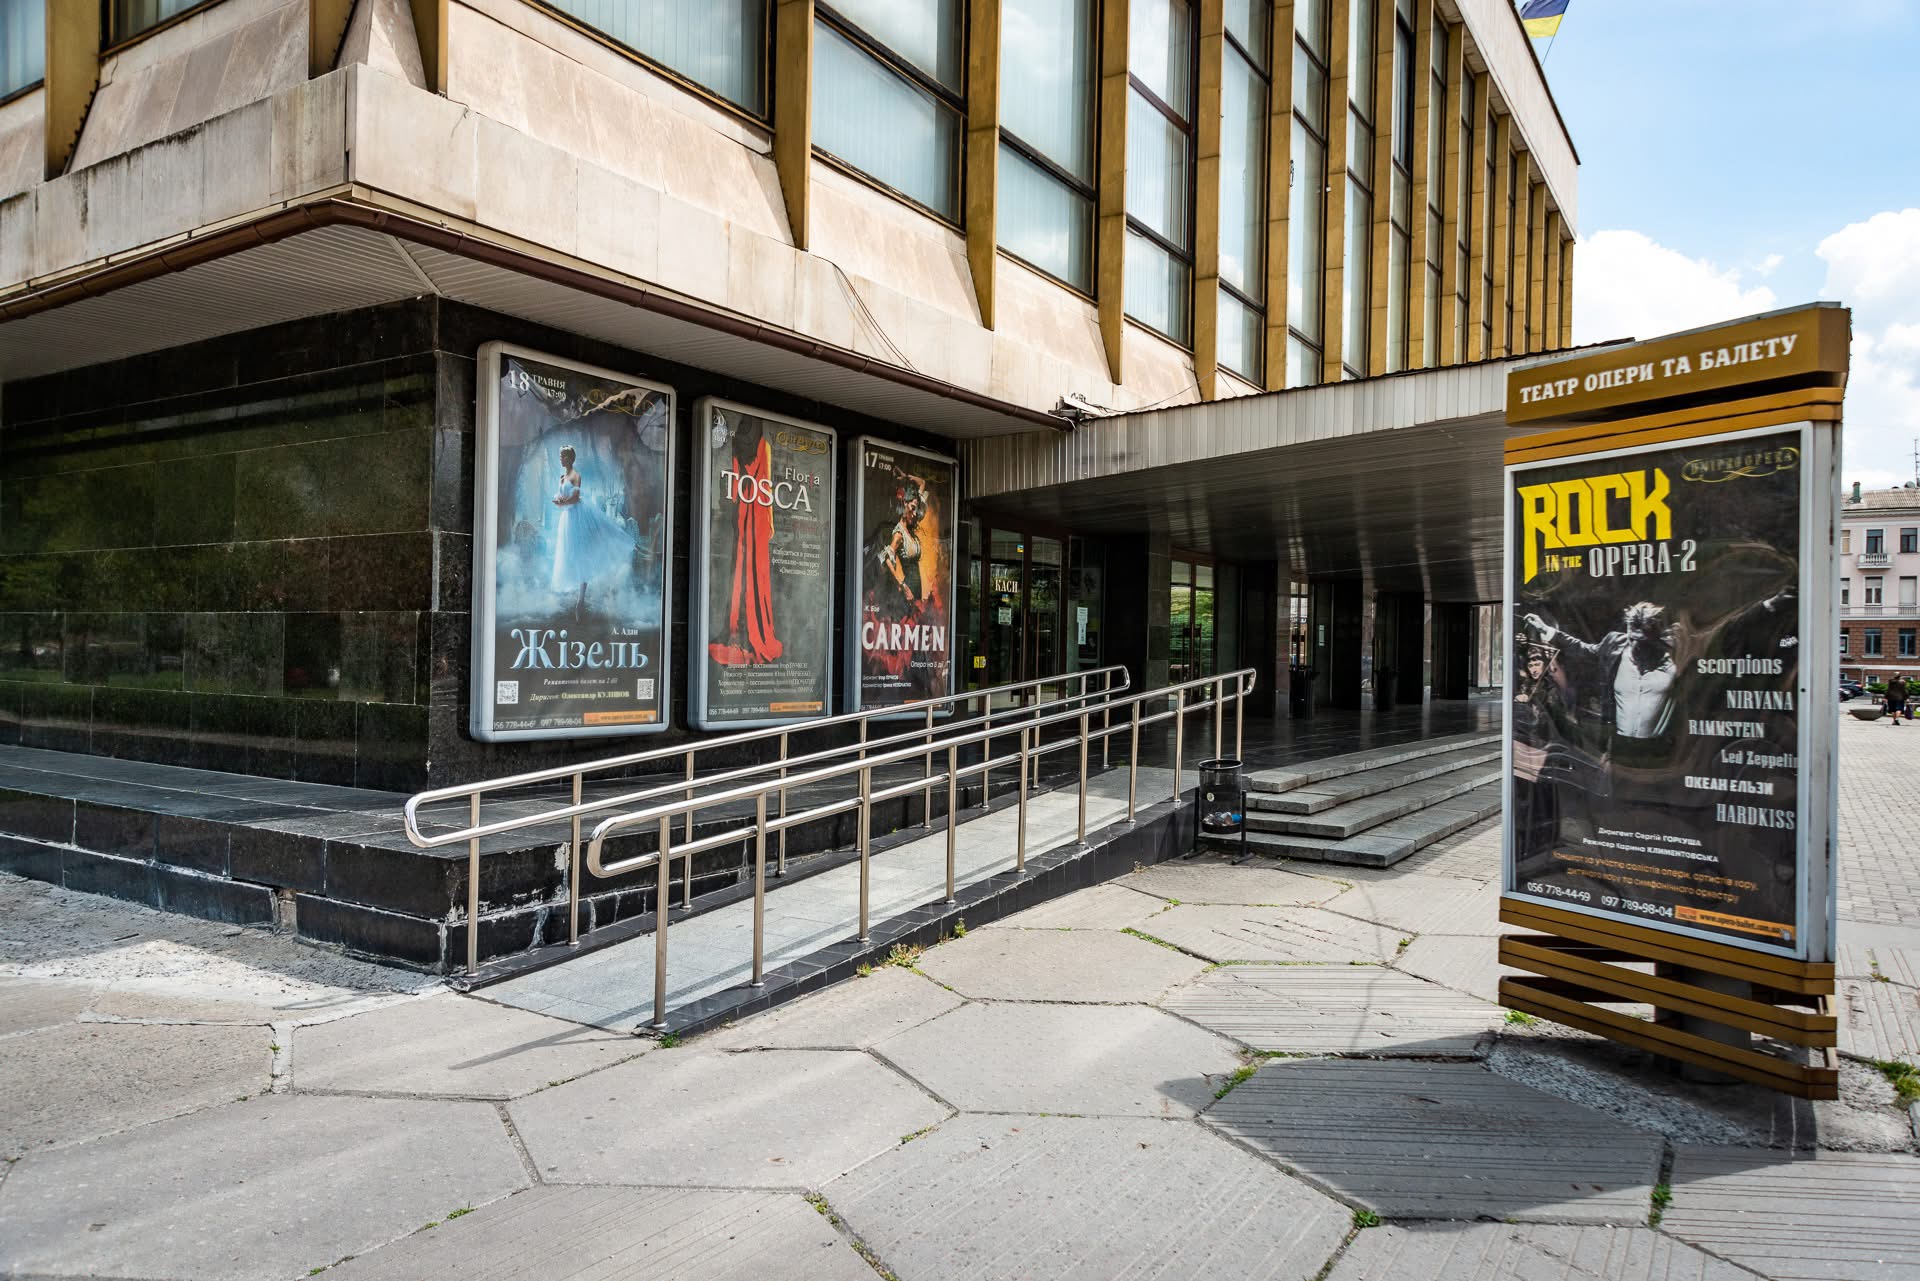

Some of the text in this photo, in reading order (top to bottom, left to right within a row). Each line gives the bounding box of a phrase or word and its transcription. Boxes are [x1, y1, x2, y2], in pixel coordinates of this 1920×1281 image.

[1520, 334, 1798, 404] ТЕАТР ОПЕРИ ТА БАЛЕТУ
[509, 370, 566, 391] 18 ТРАВНЯ
[865, 451, 878, 468] 17
[785, 467, 820, 488] Floria
[720, 470, 812, 512] TOSCA
[1516, 468, 1672, 585] ROCK
[1544, 539, 1697, 578] IN THE OPERA-2
[621, 627, 639, 636] Адан
[862, 621, 945, 651] CARMEN
[510, 628, 649, 670] Жізель
[910, 660, 926, 669] Опера
[1697, 654, 1783, 678] scorpions
[1726, 690, 1794, 710] NIRVANA
[1688, 719, 1765, 738] RAMMSTEIN
[1721, 749, 1743, 764] Led
[1684, 776, 1728, 791] ОКЕАН
[1716, 804, 1796, 830] HARDKISS
[1634, 831, 1661, 841] Сергій
[1527, 881, 1543, 893] 056
[1601, 895, 1619, 907] 097
[1621, 898, 1673, 918] 789-98-04
